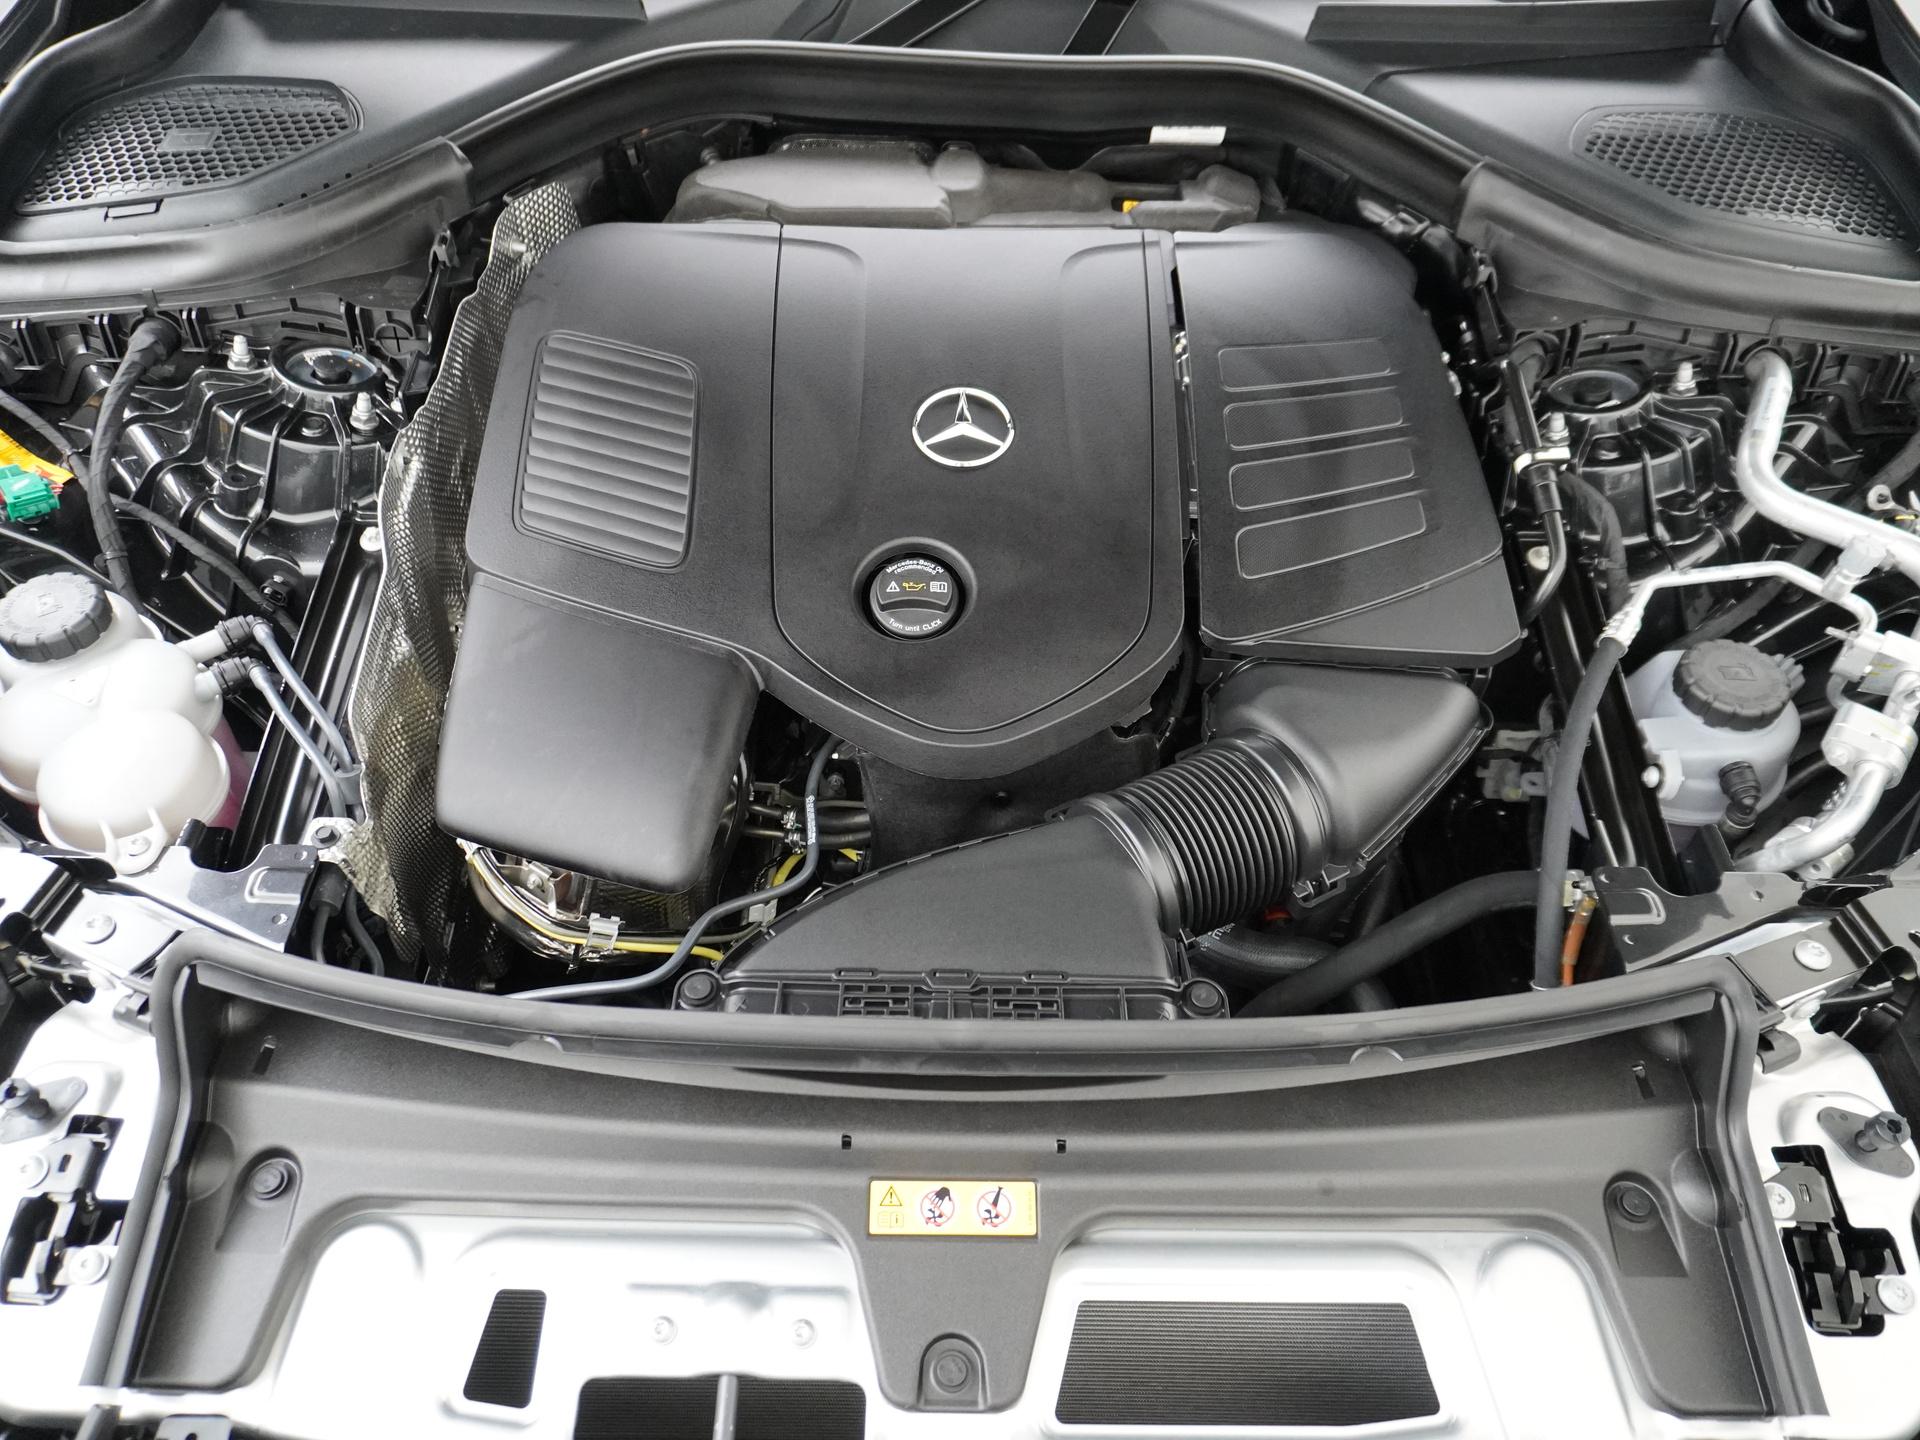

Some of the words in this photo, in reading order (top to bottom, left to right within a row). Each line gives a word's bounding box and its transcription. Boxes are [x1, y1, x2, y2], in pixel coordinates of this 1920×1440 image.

[886, 559, 935, 574] Mercedes-Benz
[894, 564, 937, 575] recommended
[888, 618, 903, 629] Turn
[904, 624, 920, 632] until
[922, 619, 943, 631] CLICK
